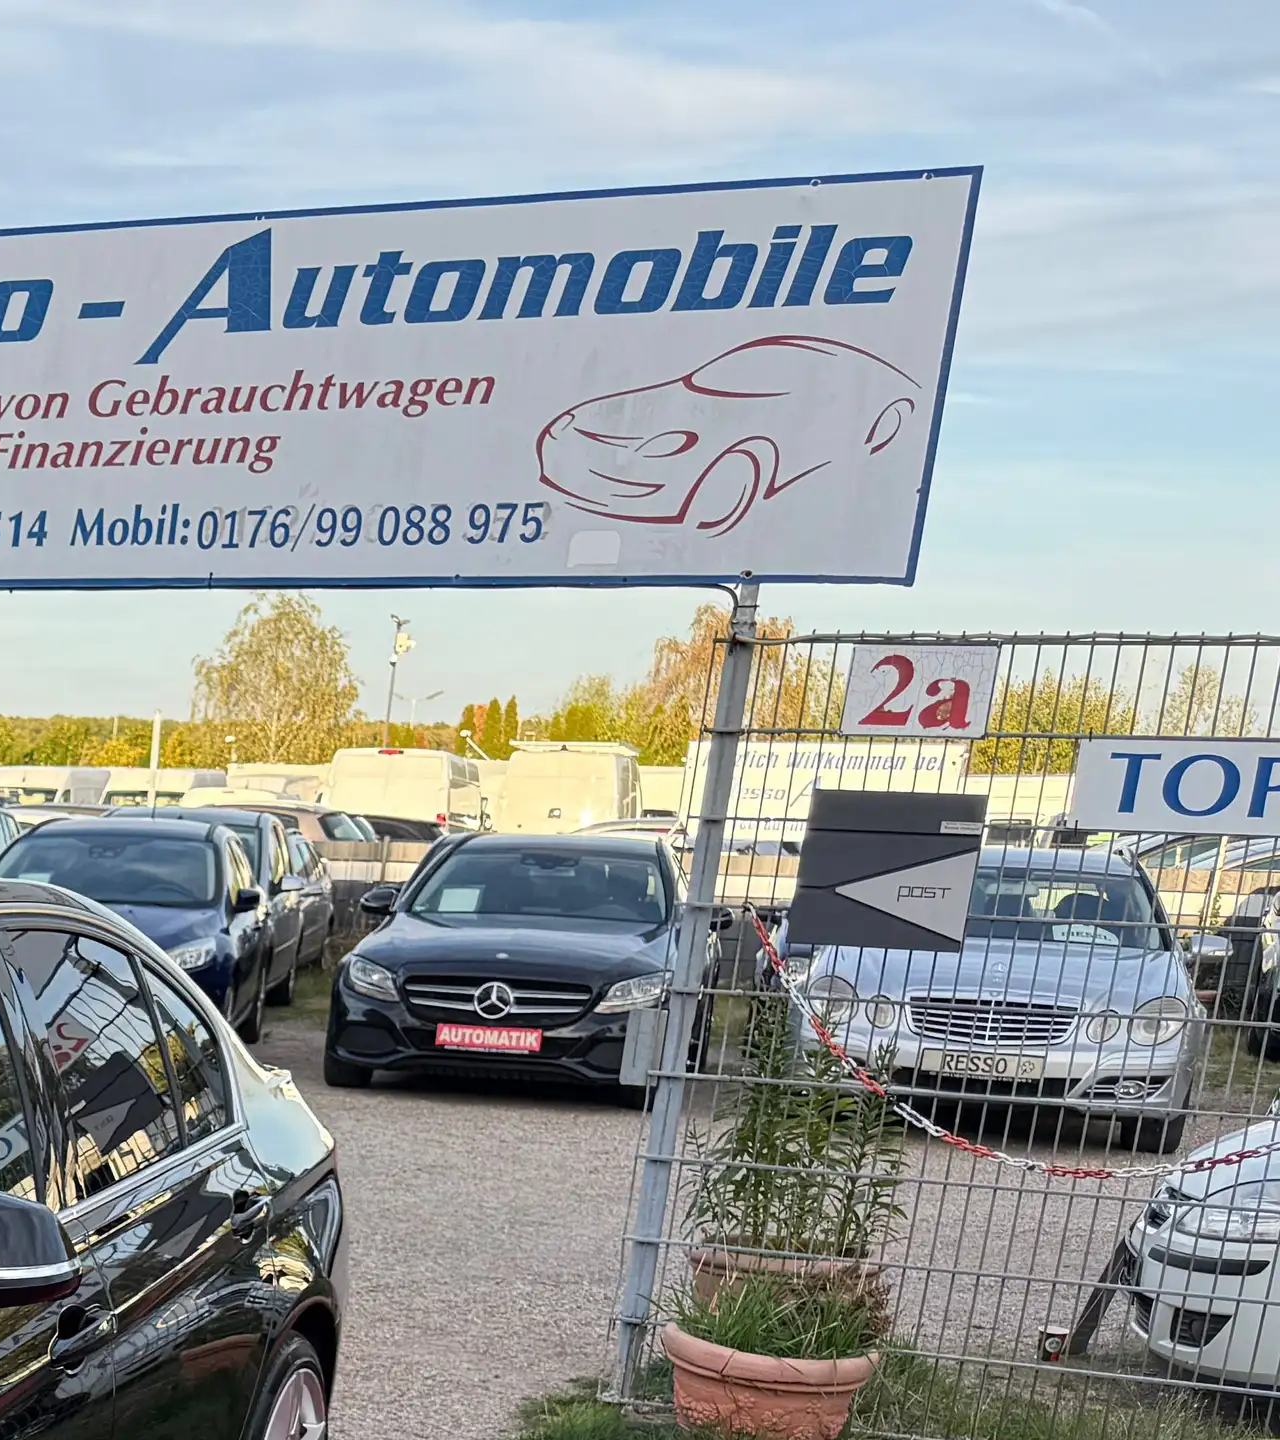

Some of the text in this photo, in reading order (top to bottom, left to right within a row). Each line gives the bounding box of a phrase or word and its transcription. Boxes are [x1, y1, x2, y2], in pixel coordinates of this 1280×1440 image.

[78, 301, 126, 319] -
[133, 225, 914, 365] Automobile
[87, 369, 497, 419] Gebrauchtwagen
[378, 504, 452, 547] 088
[466, 502, 545, 545] 975
[858, 654, 971, 730] 2a
[786, 751, 905, 770] Willkommen
[440, 1026, 538, 1047] AUTOMATIK
[942, 1053, 1008, 1074] RESSO
